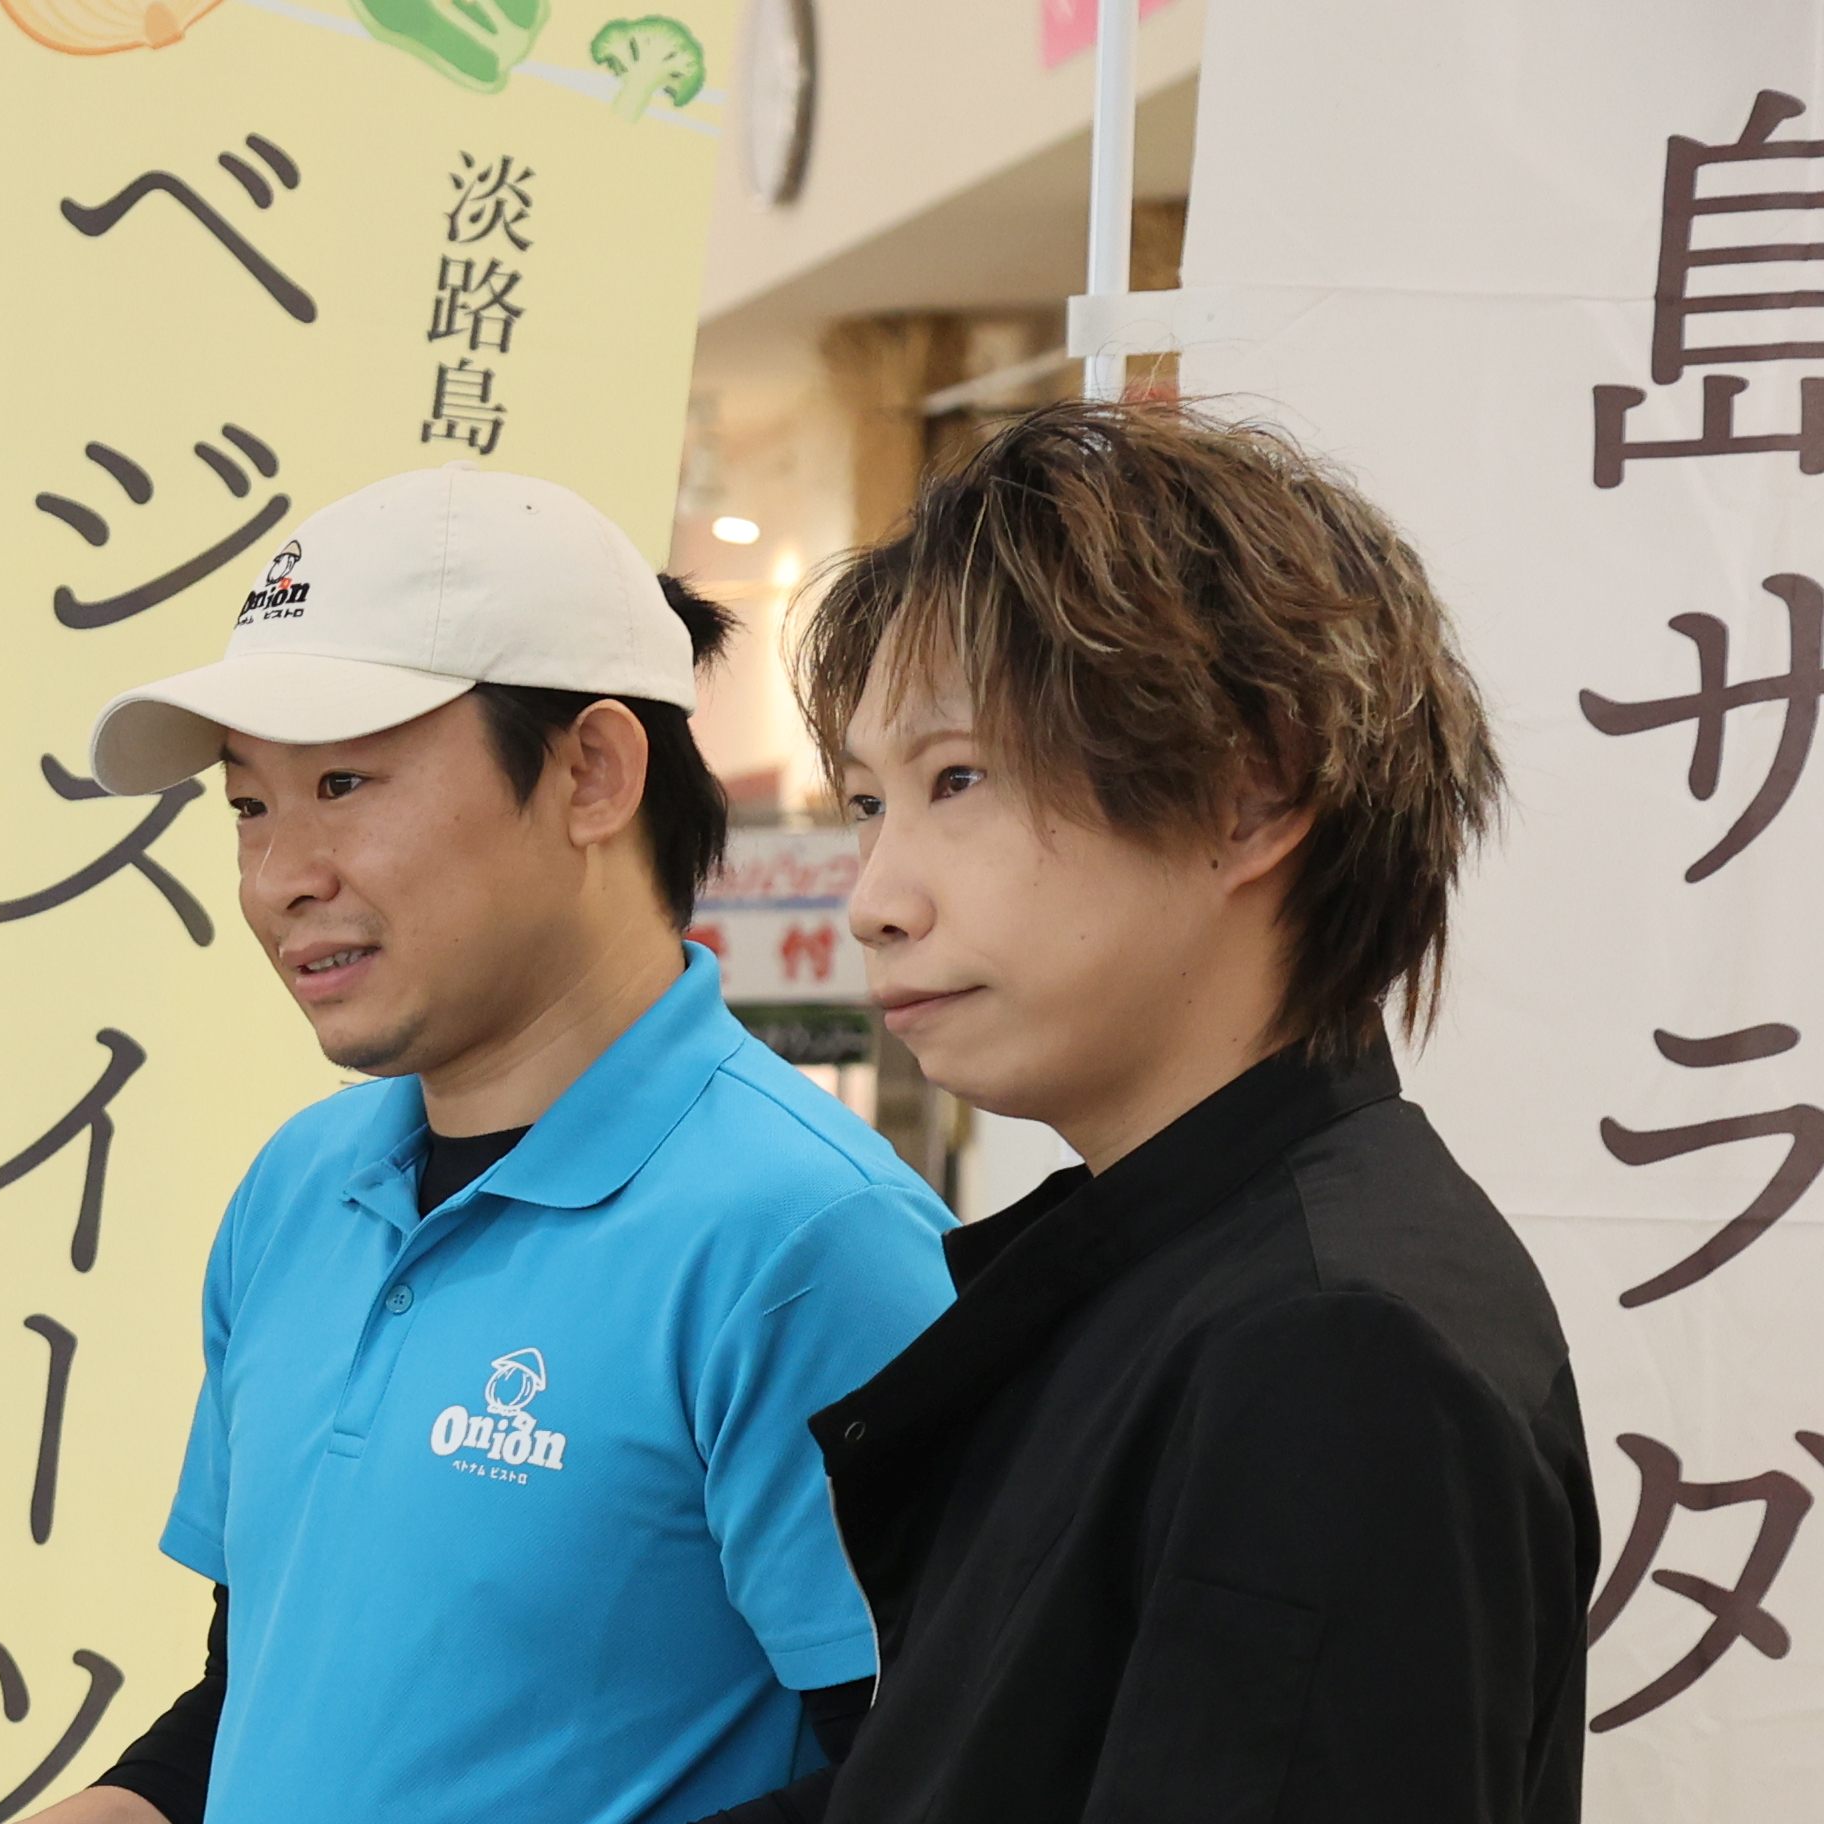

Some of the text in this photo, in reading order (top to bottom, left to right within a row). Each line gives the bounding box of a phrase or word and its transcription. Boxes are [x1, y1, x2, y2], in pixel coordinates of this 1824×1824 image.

[420, 149, 537, 457] 淡路島
[263, 608, 305, 621] ビストロ
[430, 1404, 567, 1471] Onion
[452, 1459, 529, 1486] ベトナム ビストロ
